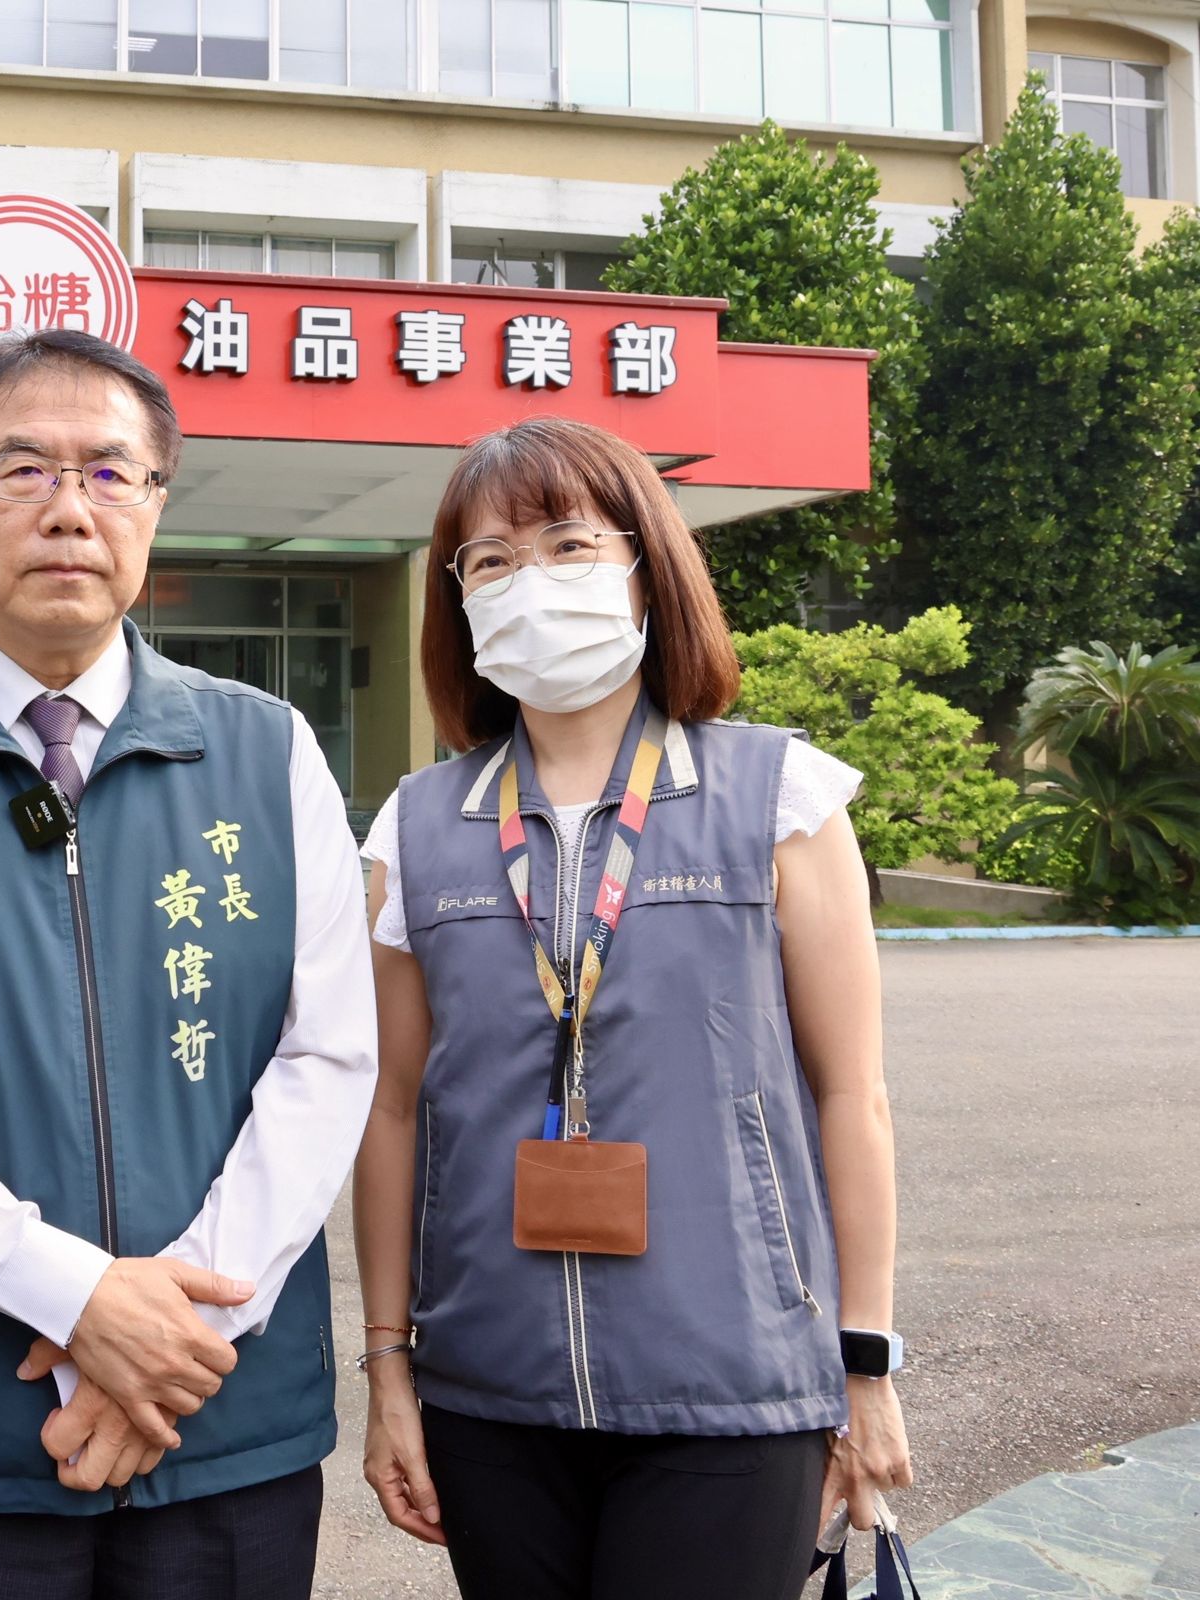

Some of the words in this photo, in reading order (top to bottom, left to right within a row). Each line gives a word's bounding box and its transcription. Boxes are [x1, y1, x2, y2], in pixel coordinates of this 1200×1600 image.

[182, 298, 677, 395] 油品事業部
[202, 820, 259, 922] 市長
[447, 897, 498, 908] FLARE
[643, 875, 723, 892] 衛生稽查人員
[154, 869, 216, 1082] 黃偉哲
[586, 912, 616, 974] Smoking
